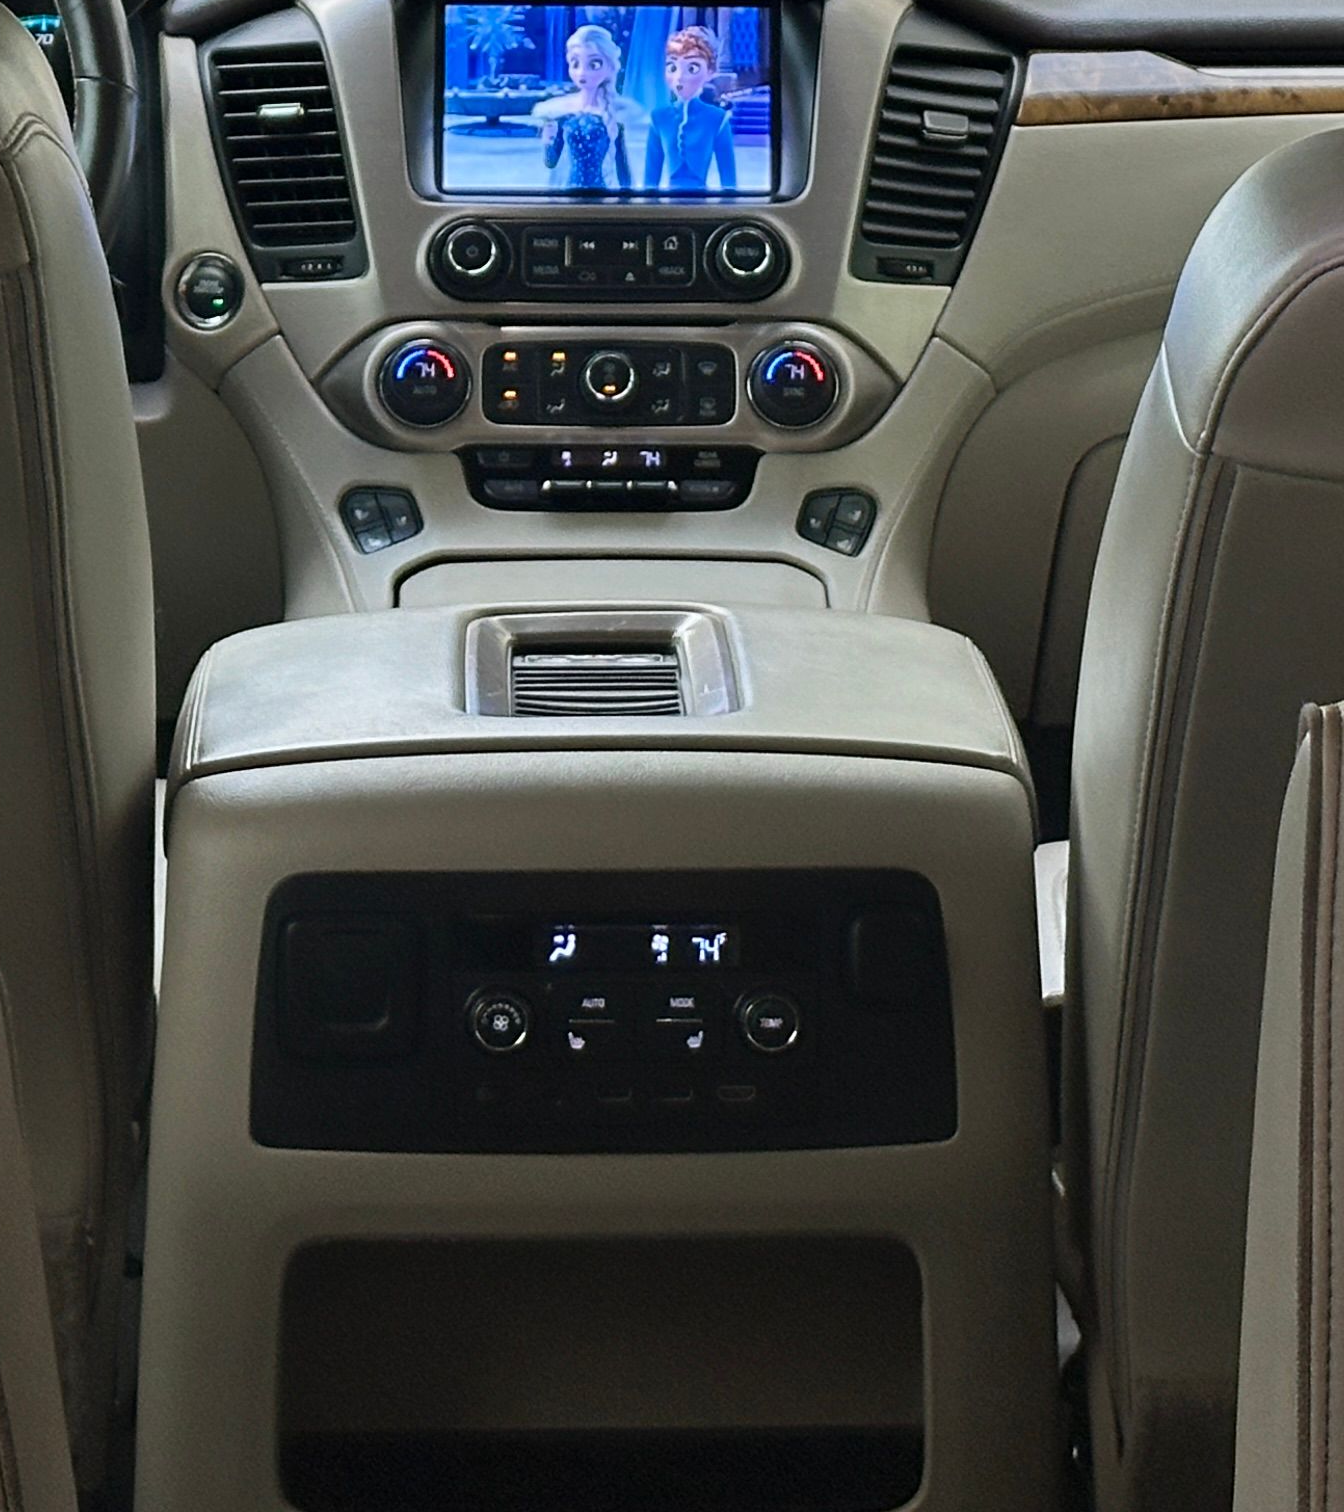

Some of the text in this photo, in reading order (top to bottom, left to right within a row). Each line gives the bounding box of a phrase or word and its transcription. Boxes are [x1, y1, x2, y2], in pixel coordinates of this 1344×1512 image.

[416, 361, 436, 378] 74
[784, 363, 805, 380] 74
[639, 450, 661, 467] 74
[582, 997, 606, 1009] AUTO
[669, 997, 695, 1009] MODE
